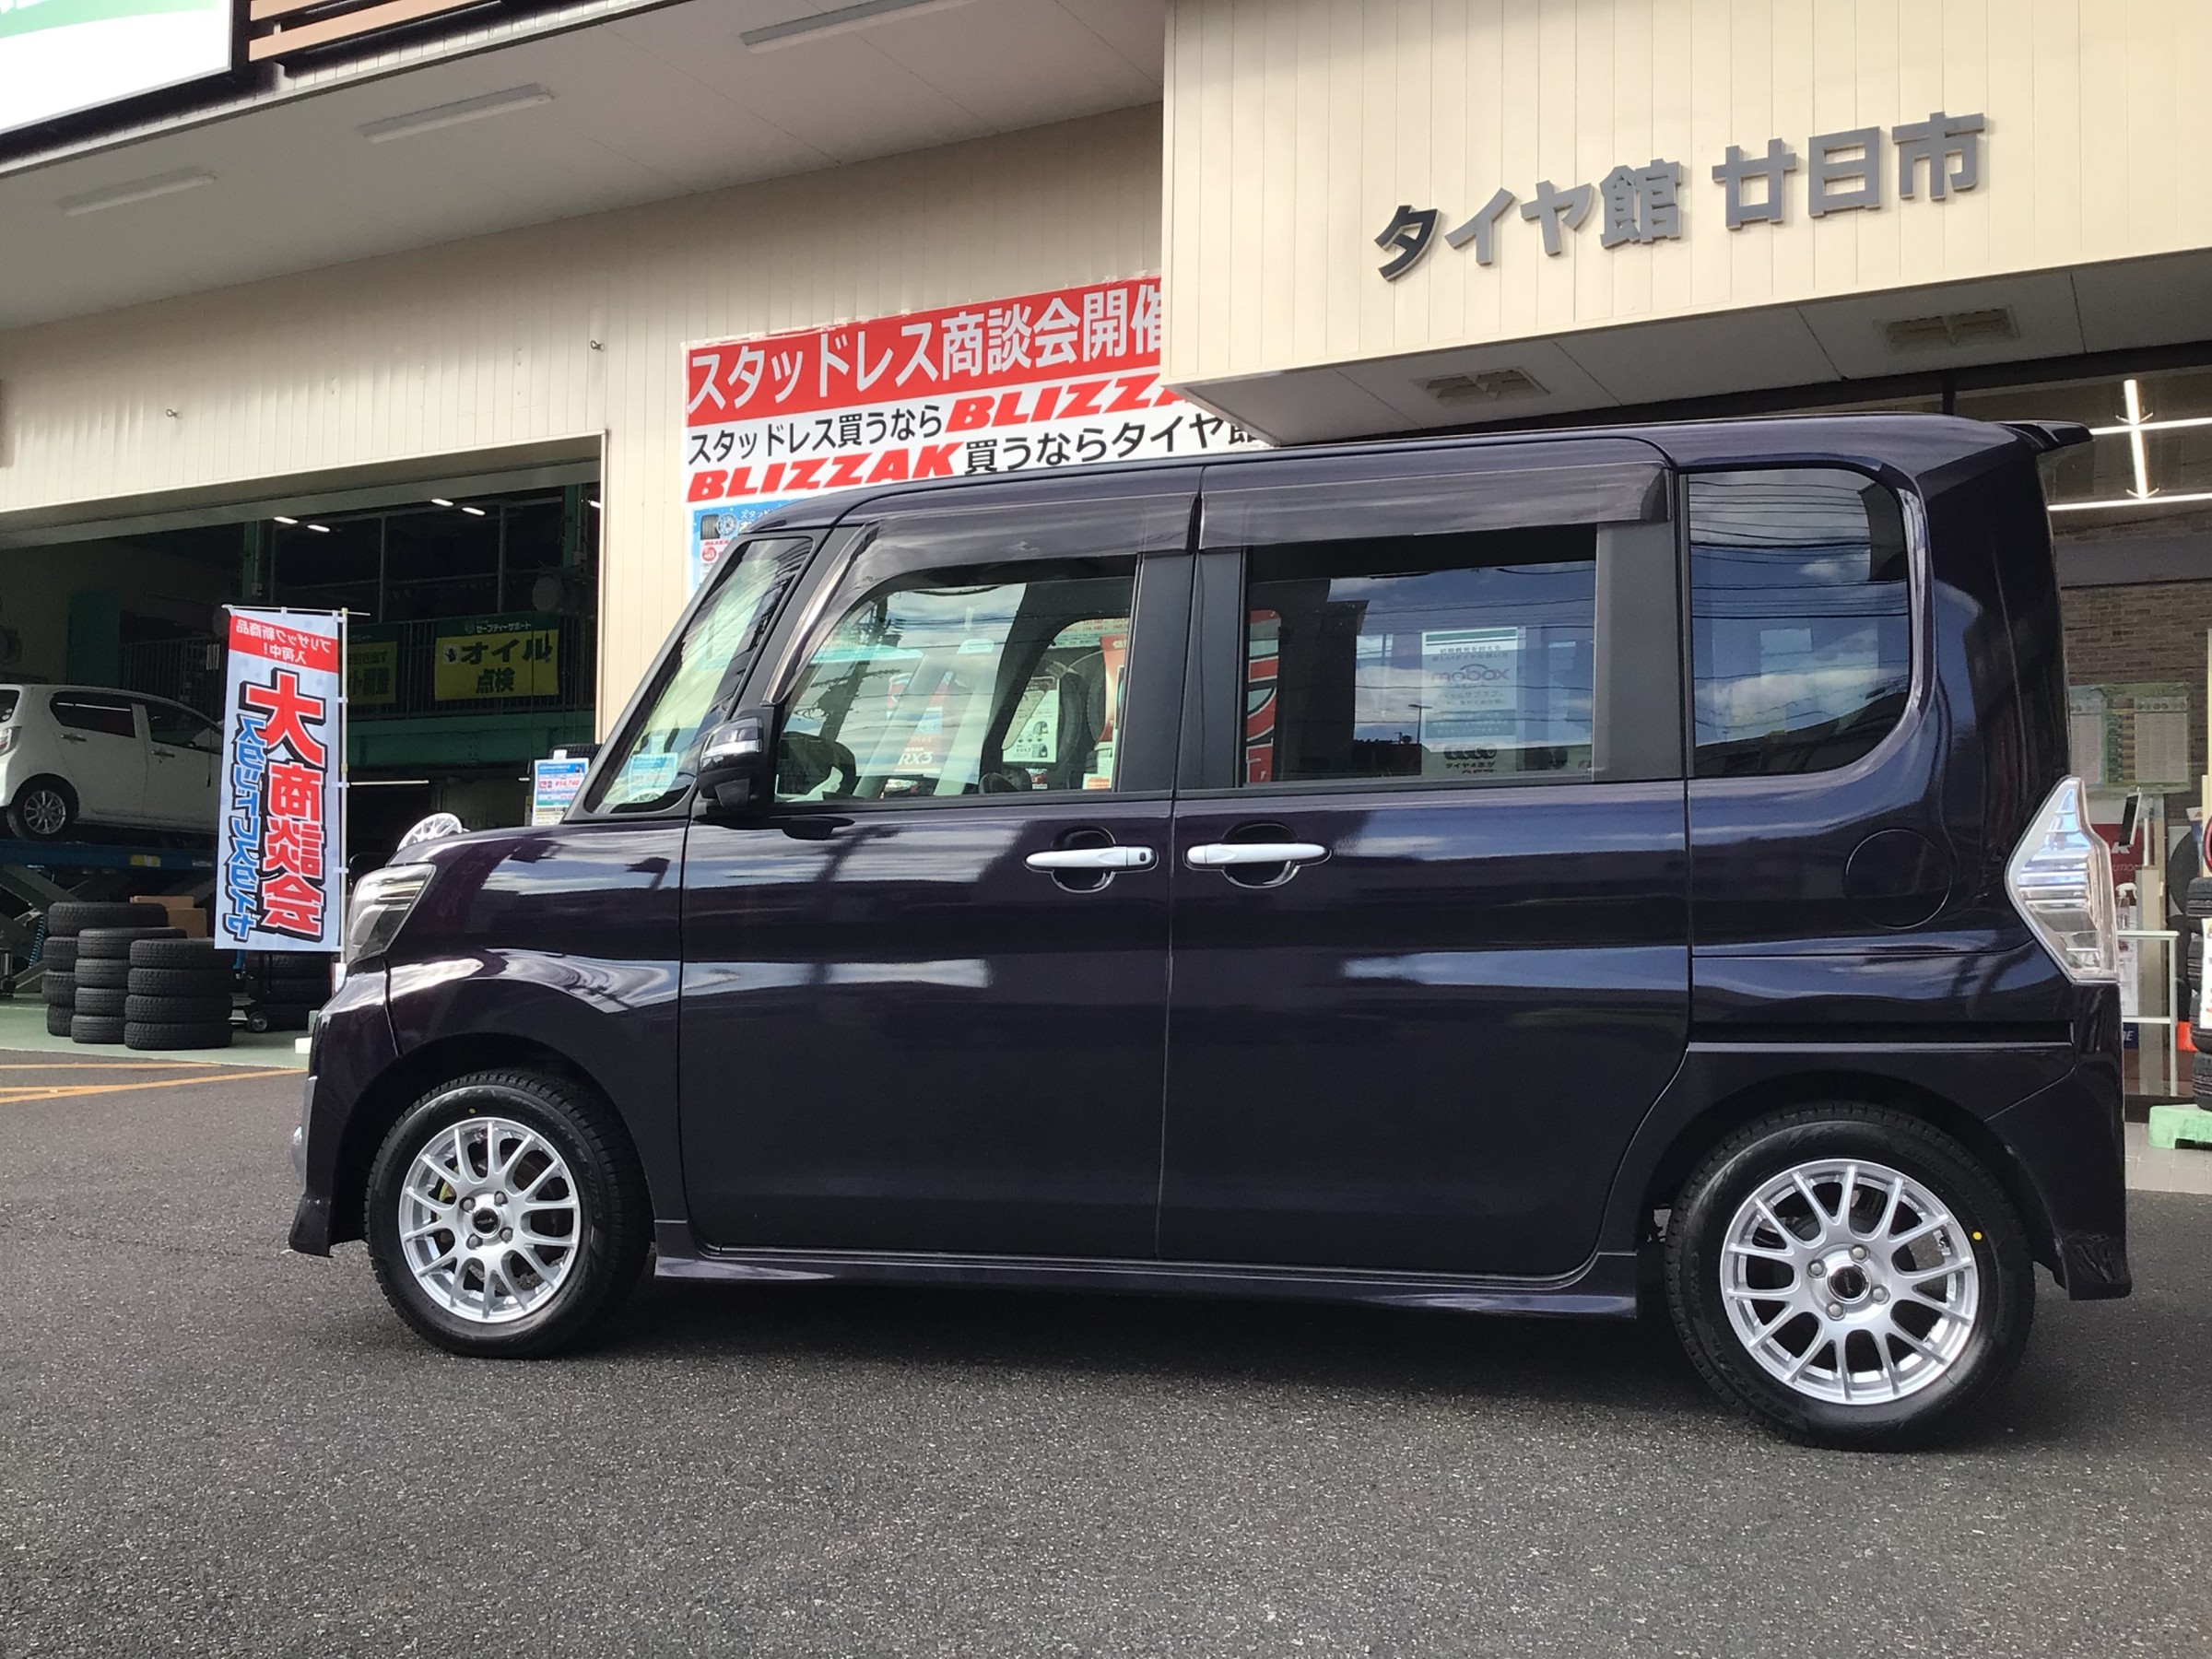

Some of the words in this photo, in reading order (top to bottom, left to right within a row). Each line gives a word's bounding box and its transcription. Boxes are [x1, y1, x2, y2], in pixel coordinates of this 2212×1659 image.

[1374, 159, 1686, 281] タイヤ館
[1712, 112, 1987, 229] 廿日市
[686, 441, 965, 503] BLIZZAK
[461, 639, 553, 665] オイル
[476, 667, 515, 693] 点検
[1432, 665, 1510, 683] mobox
